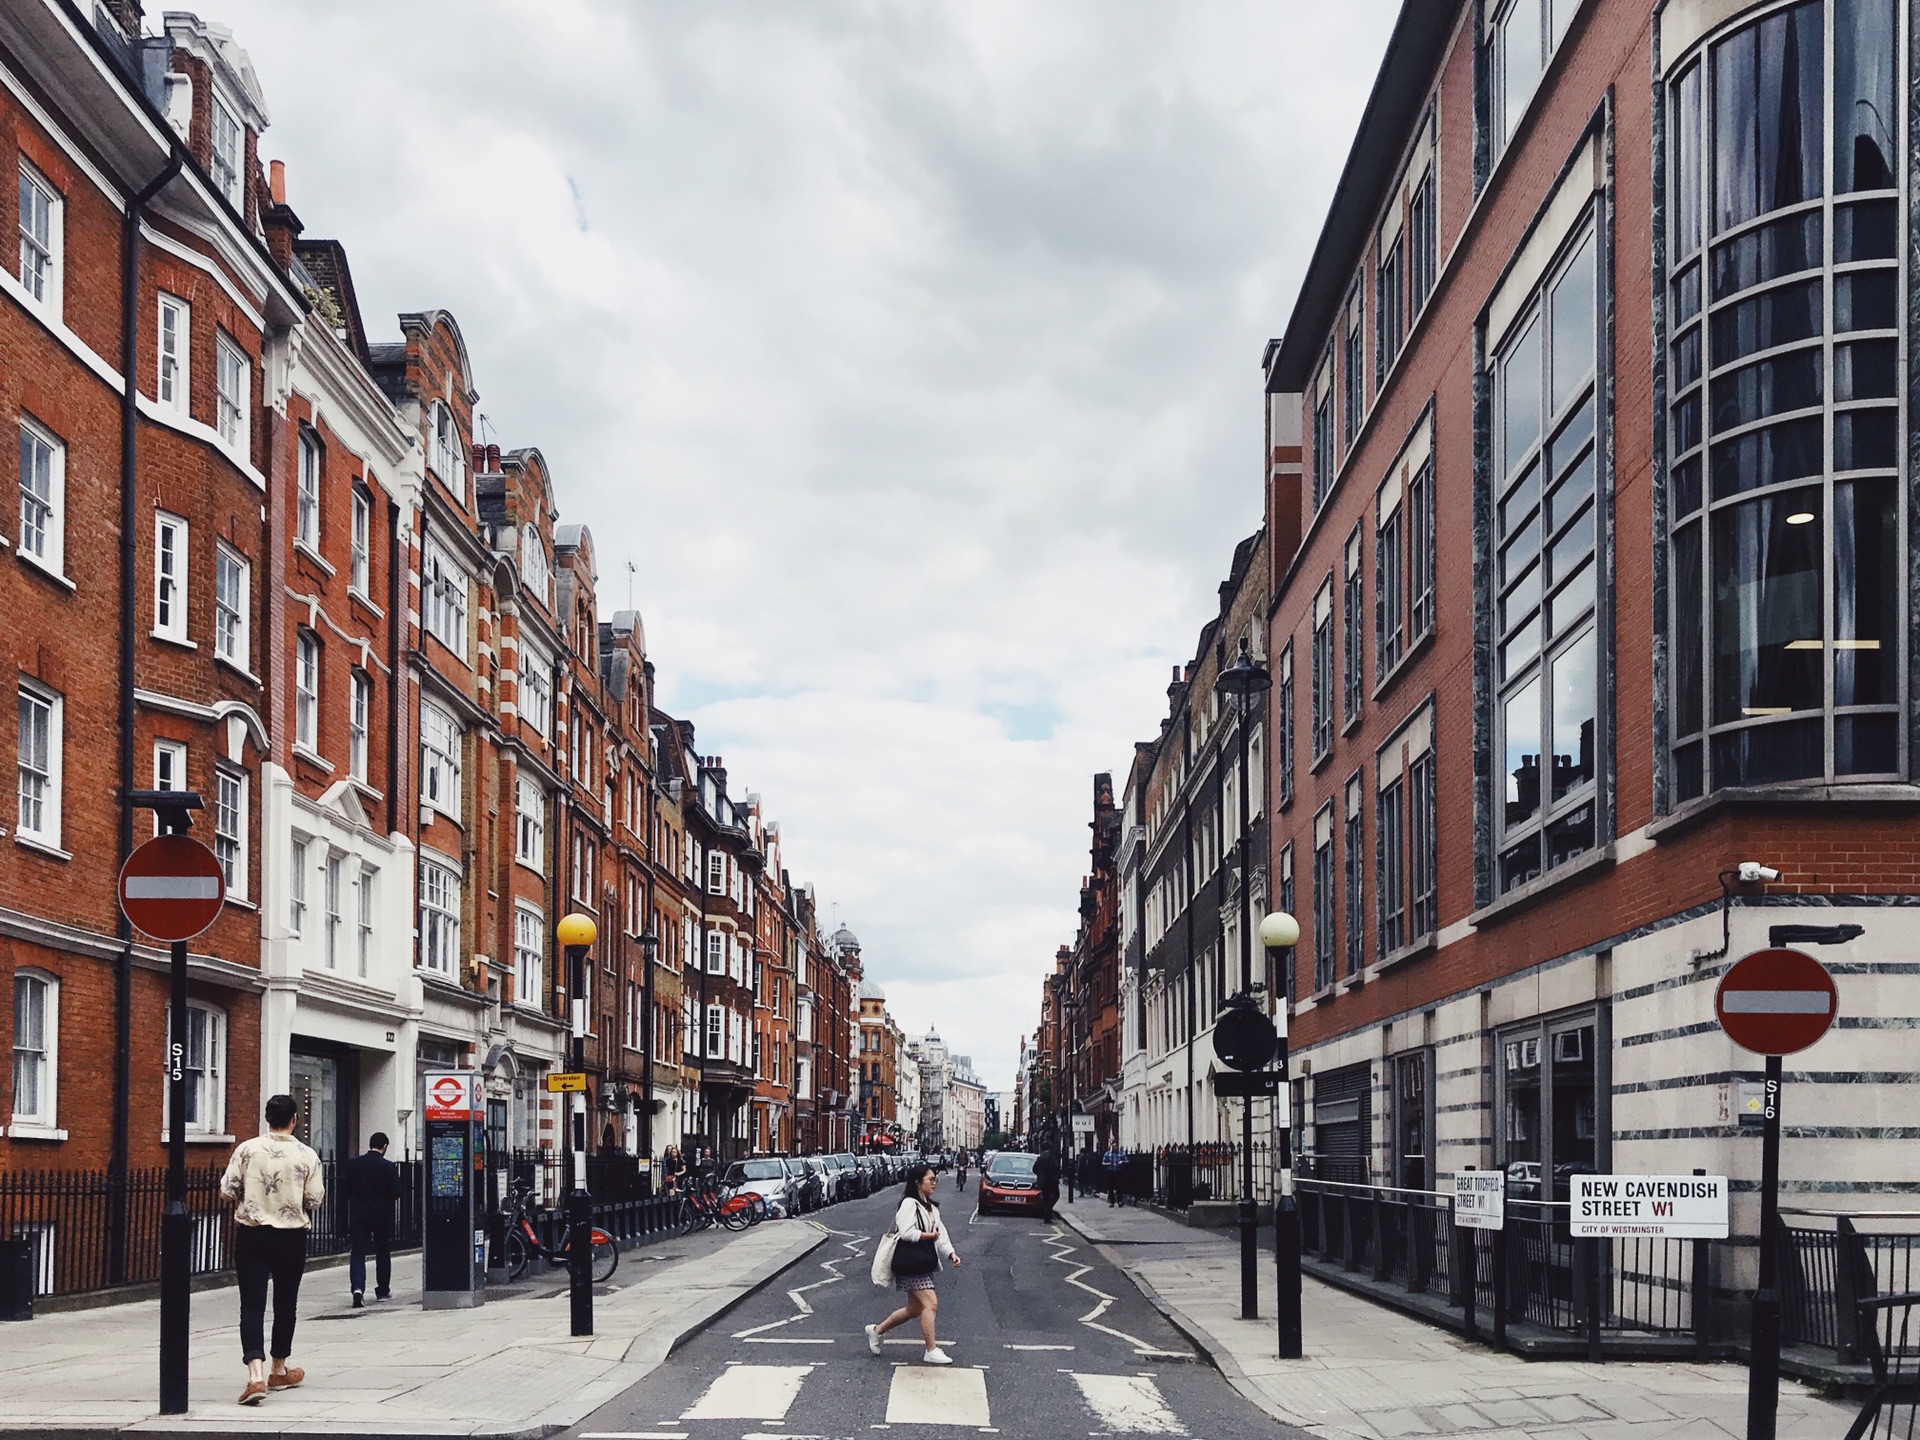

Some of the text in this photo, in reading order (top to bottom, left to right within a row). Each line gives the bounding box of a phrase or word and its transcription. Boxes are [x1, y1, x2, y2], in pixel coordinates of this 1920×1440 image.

[172, 1043, 183, 1081] S15
[1765, 1080, 1777, 1119] S16
[1457, 1177, 1473, 1190] GREAT
[1581, 1182, 1717, 1198] NEW CAVENDISH
[1457, 1194, 1475, 1208] STREET
[1582, 1201, 1673, 1216] STREET W1
[1612, 1226, 1664, 1234] WESTMINSTER
